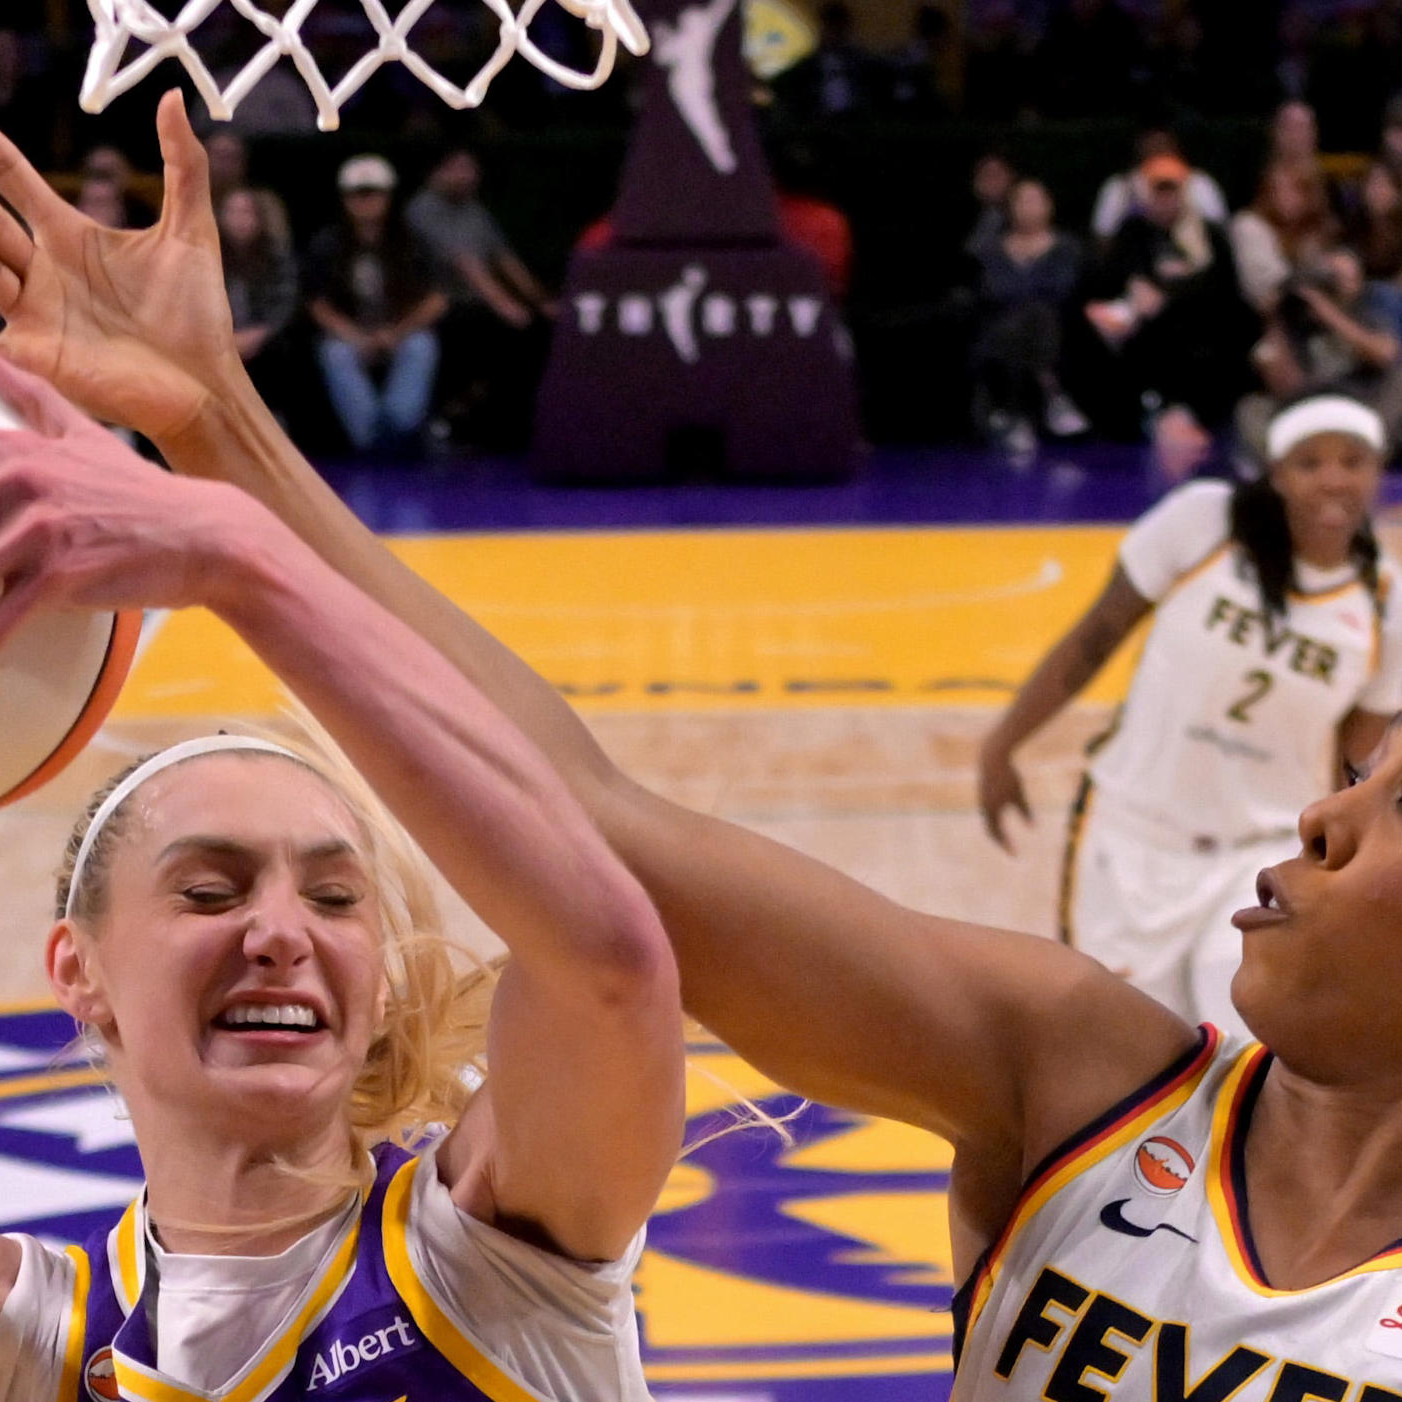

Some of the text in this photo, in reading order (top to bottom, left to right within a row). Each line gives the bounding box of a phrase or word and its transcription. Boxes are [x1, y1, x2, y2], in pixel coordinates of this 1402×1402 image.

[1206, 598, 1338, 684] FEVER
[1227, 669, 1274, 723] 2
[305, 1316, 416, 1392] Albert
